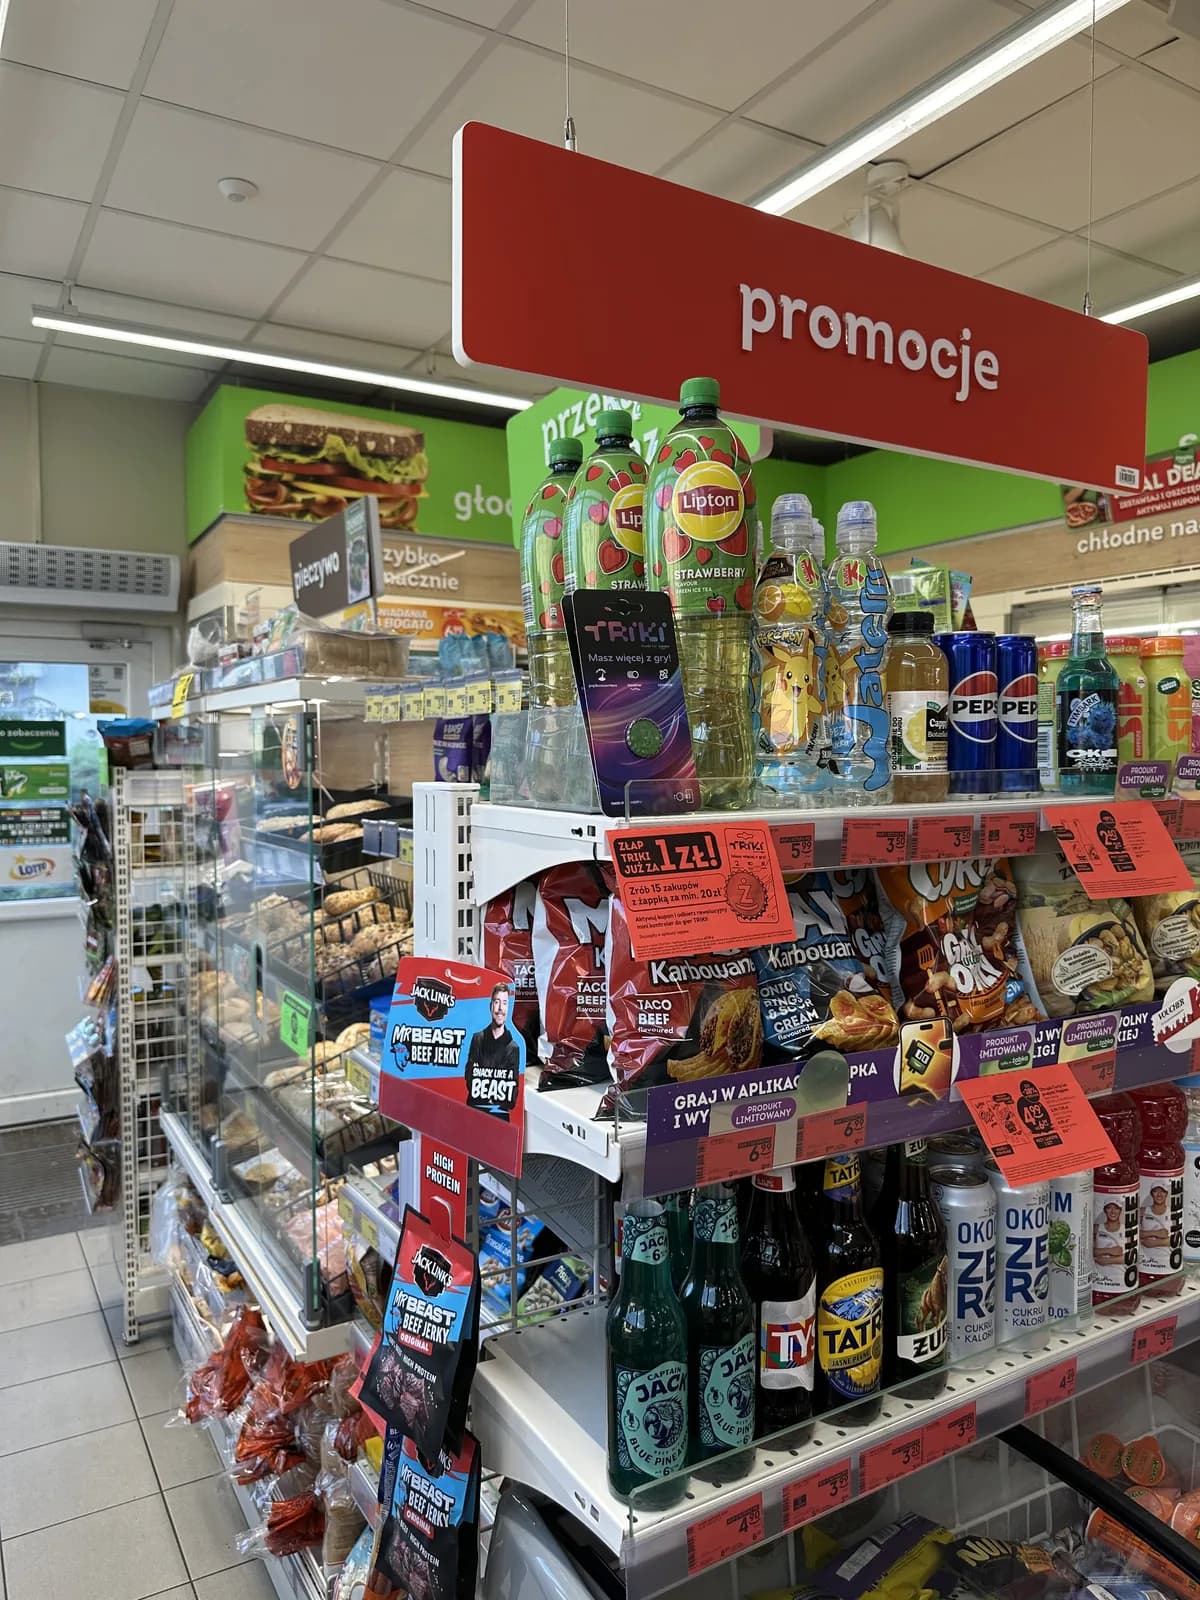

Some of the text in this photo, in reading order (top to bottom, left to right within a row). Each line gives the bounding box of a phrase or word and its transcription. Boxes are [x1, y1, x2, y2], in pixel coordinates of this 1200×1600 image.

[739, 283, 1000, 402] promocje
[1141, 462, 1200, 492] AL DEA
[683, 493, 735, 512] Lipton
[621, 511, 643, 527] Lip
[1077, 517, 1200, 554] chłodne na
[383, 545, 441, 568] zybko
[293, 551, 340, 600] pieczywo
[383, 571, 460, 591] acznie
[674, 566, 746, 580] STRAWBERRY
[611, 579, 646, 591] STRAW
[701, 586, 712, 594] TEA
[377, 607, 428, 619] NIADANIA
[588, 653, 614, 662] Masz
[616, 653, 645, 665] więcej
[653, 653, 672, 664] gry!
[952, 698, 998, 715] PEPS
[1001, 700, 1038, 716] PEP
[1068, 693, 1100, 726] TYMBARK
[929, 718, 948, 730] Capp
[7, 729, 60, 738] zobaczenia
[1130, 766, 1157, 775] PRODUKT
[1179, 767, 1200, 776] LIMITO
[1121, 774, 1165, 785] LIMITOWANY
[618, 840, 645, 851] ZŁAP
[620, 852, 651, 862] TRIKI
[18, 861, 48, 877] LOTTO
[624, 861, 660, 874] JUŻ ZA
[628, 881, 699, 896] Zrób 15 zakupów
[639, 896, 670, 906] żappką
[681, 892, 699, 900] min.
[769, 940, 856, 969] Karbowan
[514, 964, 536, 976] TAC
[514, 977, 535, 989] BEE
[1005, 981, 1020, 996] EW
[410, 983, 456, 1009] JACK LINK'S
[514, 989, 538, 997] flavour
[764, 992, 804, 1008] RINGS
[576, 1006, 607, 1014] flavoure
[637, 999, 672, 1011] TACO
[779, 998, 814, 1016] SOUR
[1157, 998, 1185, 1020] VOUCHER
[638, 1013, 670, 1025] BEEF
[773, 1009, 819, 1033] CREAM
[1076, 1019, 1106, 1031] PRODUKT
[1119, 1012, 1149, 1028] OLNY
[637, 1026, 674, 1035] flavoured
[1066, 1027, 1114, 1042] LIMITOWANY
[985, 1034, 1019, 1047] PRODUKT
[411, 1045, 462, 1065] BEEF JERKY
[979, 1043, 1028, 1059] IMITOWANY
[472, 1067, 514, 1079] SNACK LIKE A
[471, 1077, 517, 1102] BEAST
[674, 1061, 878, 1110] GRAJ W PKA
[747, 1101, 782, 1113] PRODUKT
[673, 1108, 711, 1129] I WY
[735, 1107, 792, 1125] LIMITOWANY
[433, 1151, 454, 1173] HIGH
[426, 1165, 461, 1195] PROTEIN
[829, 1161, 861, 1184] TATR
[720, 1216, 739, 1233] JAC
[958, 1218, 997, 1244] OKO
[1170, 1177, 1184, 1270] OSHEE
[1124, 1193, 1139, 1288] OSHEE
[411, 1250, 432, 1274] JACK
[652, 1249, 661, 1261] 6
[1012, 1307, 1043, 1317] CUKRU
[403, 1312, 450, 1345] BEEF JERKY
[822, 1312, 882, 1354] TATR
[400, 1333, 430, 1352] ORIGINAL
[964, 1331, 994, 1343] KALORI
[720, 1346, 755, 1378] JAC
[832, 1356, 851, 1367] JASNE
[414, 1363, 437, 1383] PROTEIN
[647, 1367, 682, 1381] CAPTAIN
[635, 1372, 687, 1403] JACK
[713, 1412, 735, 1436] BLUE
[743, 1435, 750, 1445] 6
[629, 1437, 653, 1464] BLUE
[662, 1466, 670, 1476] 6
[409, 1491, 450, 1528] BEEF JERKY
[406, 1509, 431, 1534] ORIGINAL
[419, 1544, 440, 1568] PROTEIN
